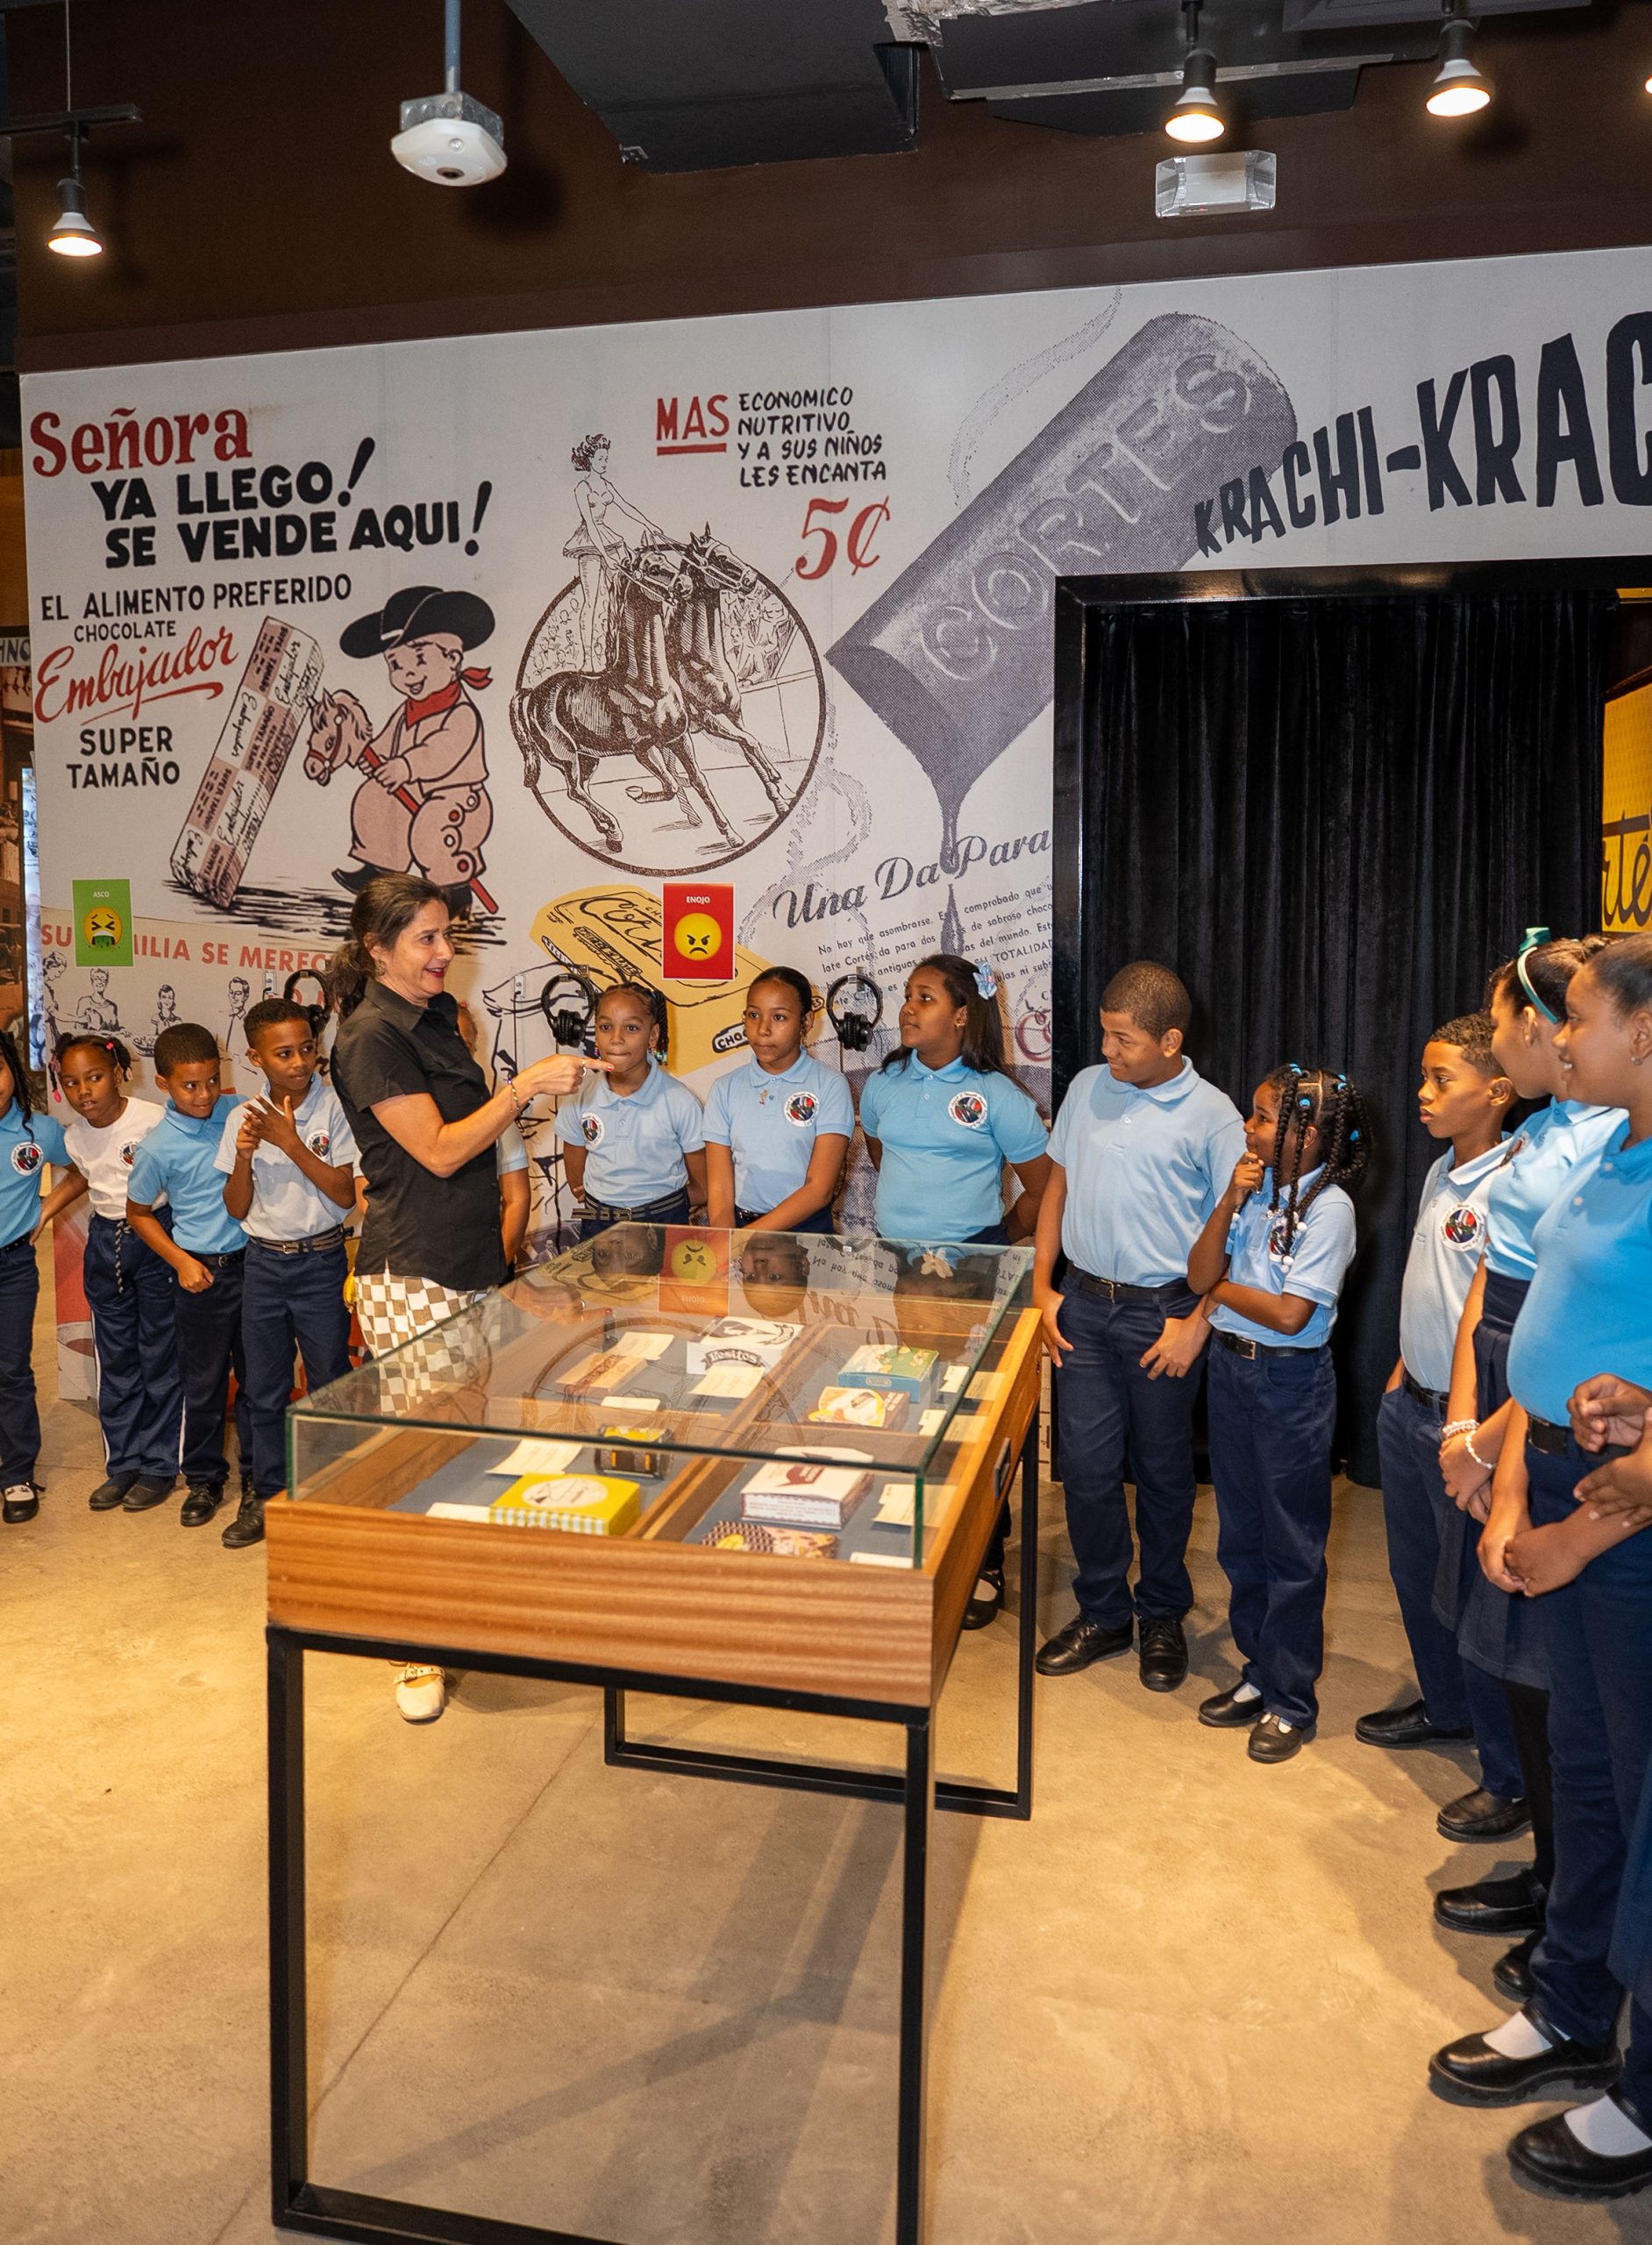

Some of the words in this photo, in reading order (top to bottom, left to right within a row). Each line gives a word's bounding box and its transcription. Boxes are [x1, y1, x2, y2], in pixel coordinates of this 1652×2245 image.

[656, 394, 730, 441] MAS
[738, 387, 853, 412] ECONOMICO
[30, 407, 253, 478] Señora
[737, 411, 851, 437] NUTRITIVO
[737, 442, 750, 460] Y
[757, 441, 770, 460] A
[781, 438, 817, 460] SUS
[824, 430, 882, 458] NIÑOS
[90, 478, 157, 521] YA
[176, 438, 375, 515] LLEGO!
[739, 465, 780, 488] LES
[786, 460, 887, 486] ENCANTA
[104, 526, 157, 568] SE
[175, 511, 338, 563] VENDE
[348, 481, 493, 556] AQUI!
[794, 495, 891, 581] 5¢
[41, 595, 69, 621] EL
[82, 585, 205, 619] ALIMENTO
[213, 574, 352, 609] PREFERIDO
[74, 620, 176, 643] CHOCOLATE
[34, 625, 239, 723] Embajador
[80, 726, 174, 756] SUPER
[67, 757, 180, 789] TAMAÑO
[686, 895, 710, 905] ENOJO
[772, 883, 867, 929] Una
[874, 857, 940, 901] Da
[951, 830, 1052, 880] Para
[41, 923, 72, 948] SU
[201, 943, 228, 966] SE
[817, 944, 832, 955] No
[837, 939, 852, 950] hay
[858, 933, 874, 944] que
[879, 917, 933, 937] asombrarse.
[964, 891, 1019, 914] comprobado
[1024, 887, 1042, 899] que
[822, 963, 841, 973] late
[879, 947, 890, 957] da
[895, 940, 916, 954] para
[921, 935, 936, 945] dos
[971, 922, 982, 931] de
[987, 912, 1022, 926] sabroso
[878, 959, 918, 975] antiguas
[979, 936, 994, 948] del
[1036, 922, 1052, 932] Est
[1020, 966, 1029, 976] ni
